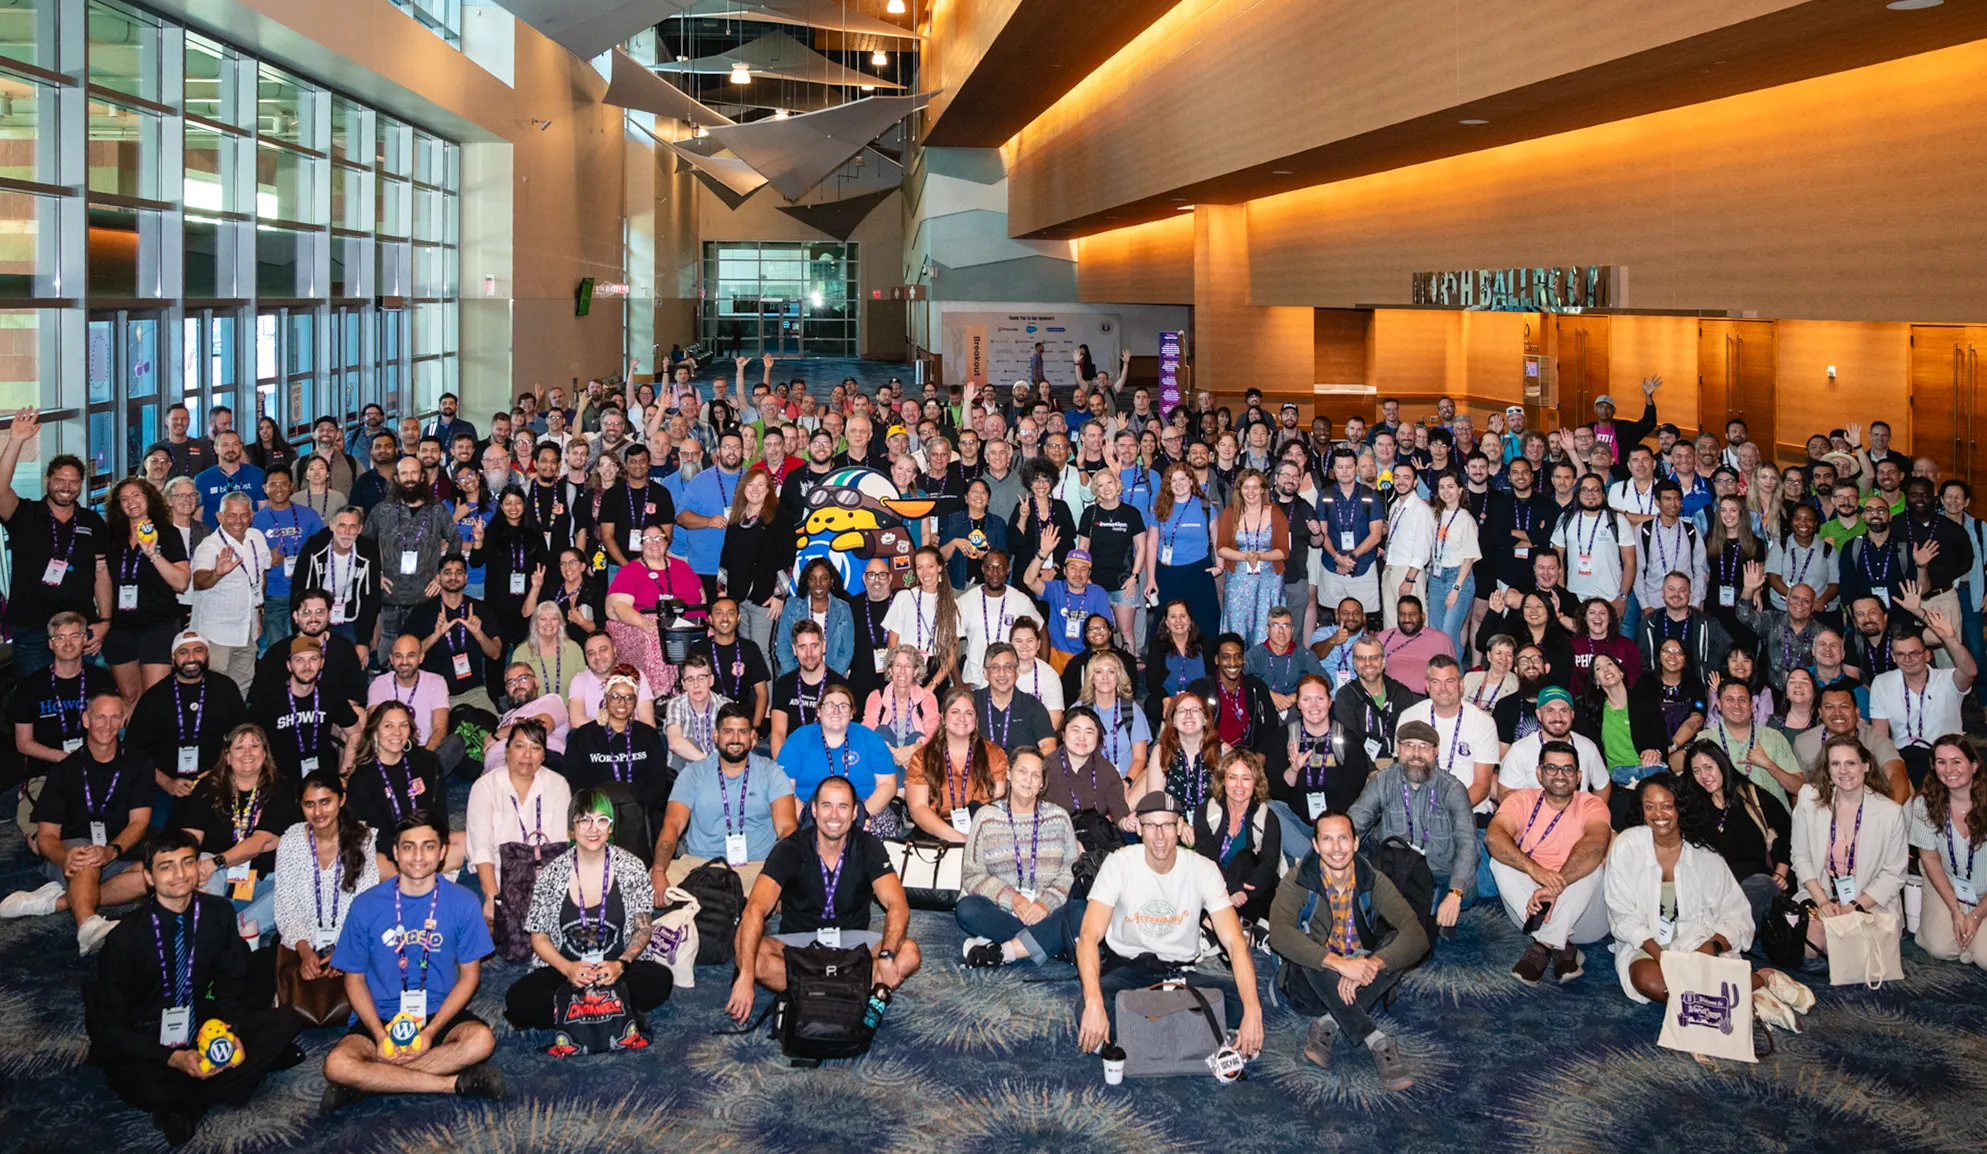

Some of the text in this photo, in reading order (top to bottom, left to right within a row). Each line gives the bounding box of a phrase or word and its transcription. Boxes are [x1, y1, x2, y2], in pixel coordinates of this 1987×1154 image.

[1412, 266, 1611, 308] NORTH BALLROOM
[973, 336, 981, 376] Breakout
[40, 699, 89, 714] Howd
[276, 710, 327, 730] SHOWT
[567, 1001, 623, 1020] CHANNEL
